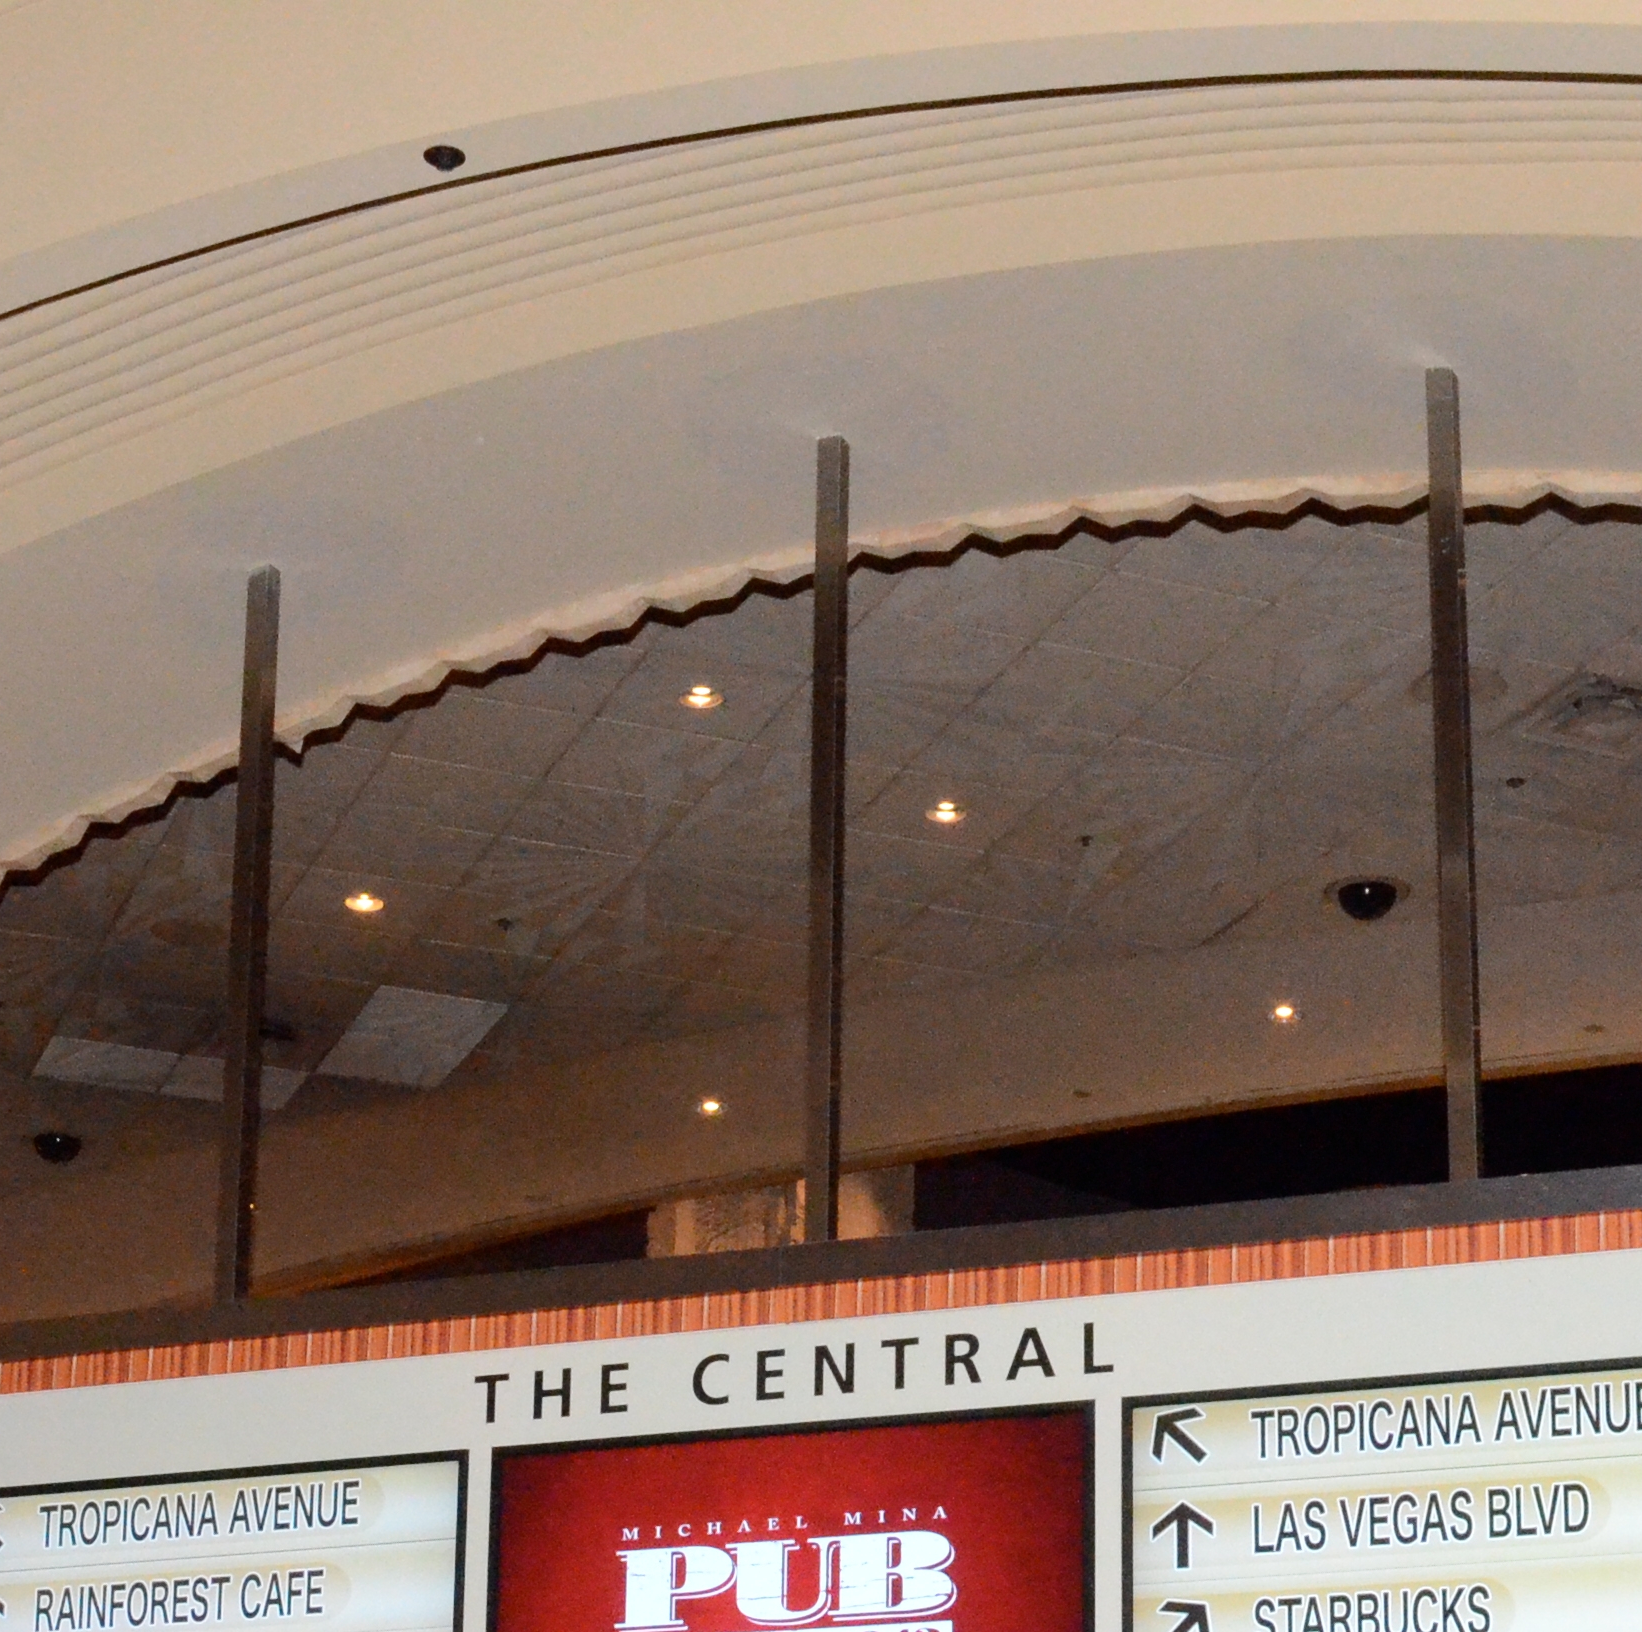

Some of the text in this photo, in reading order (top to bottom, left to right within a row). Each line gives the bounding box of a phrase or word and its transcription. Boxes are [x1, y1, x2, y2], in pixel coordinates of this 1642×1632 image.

[474, 1322, 1115, 1424] THE CENTRAL
[1251, 1395, 1481, 1458] TROPICANA
[39, 1480, 361, 1548] TROPICANA AVENUE
[621, 1506, 949, 1542] MICHAEL MINA
[1254, 1484, 1590, 1553] LAS VEGAS BLVD
[35, 1570, 324, 1632] RAINFOREST CAFE
